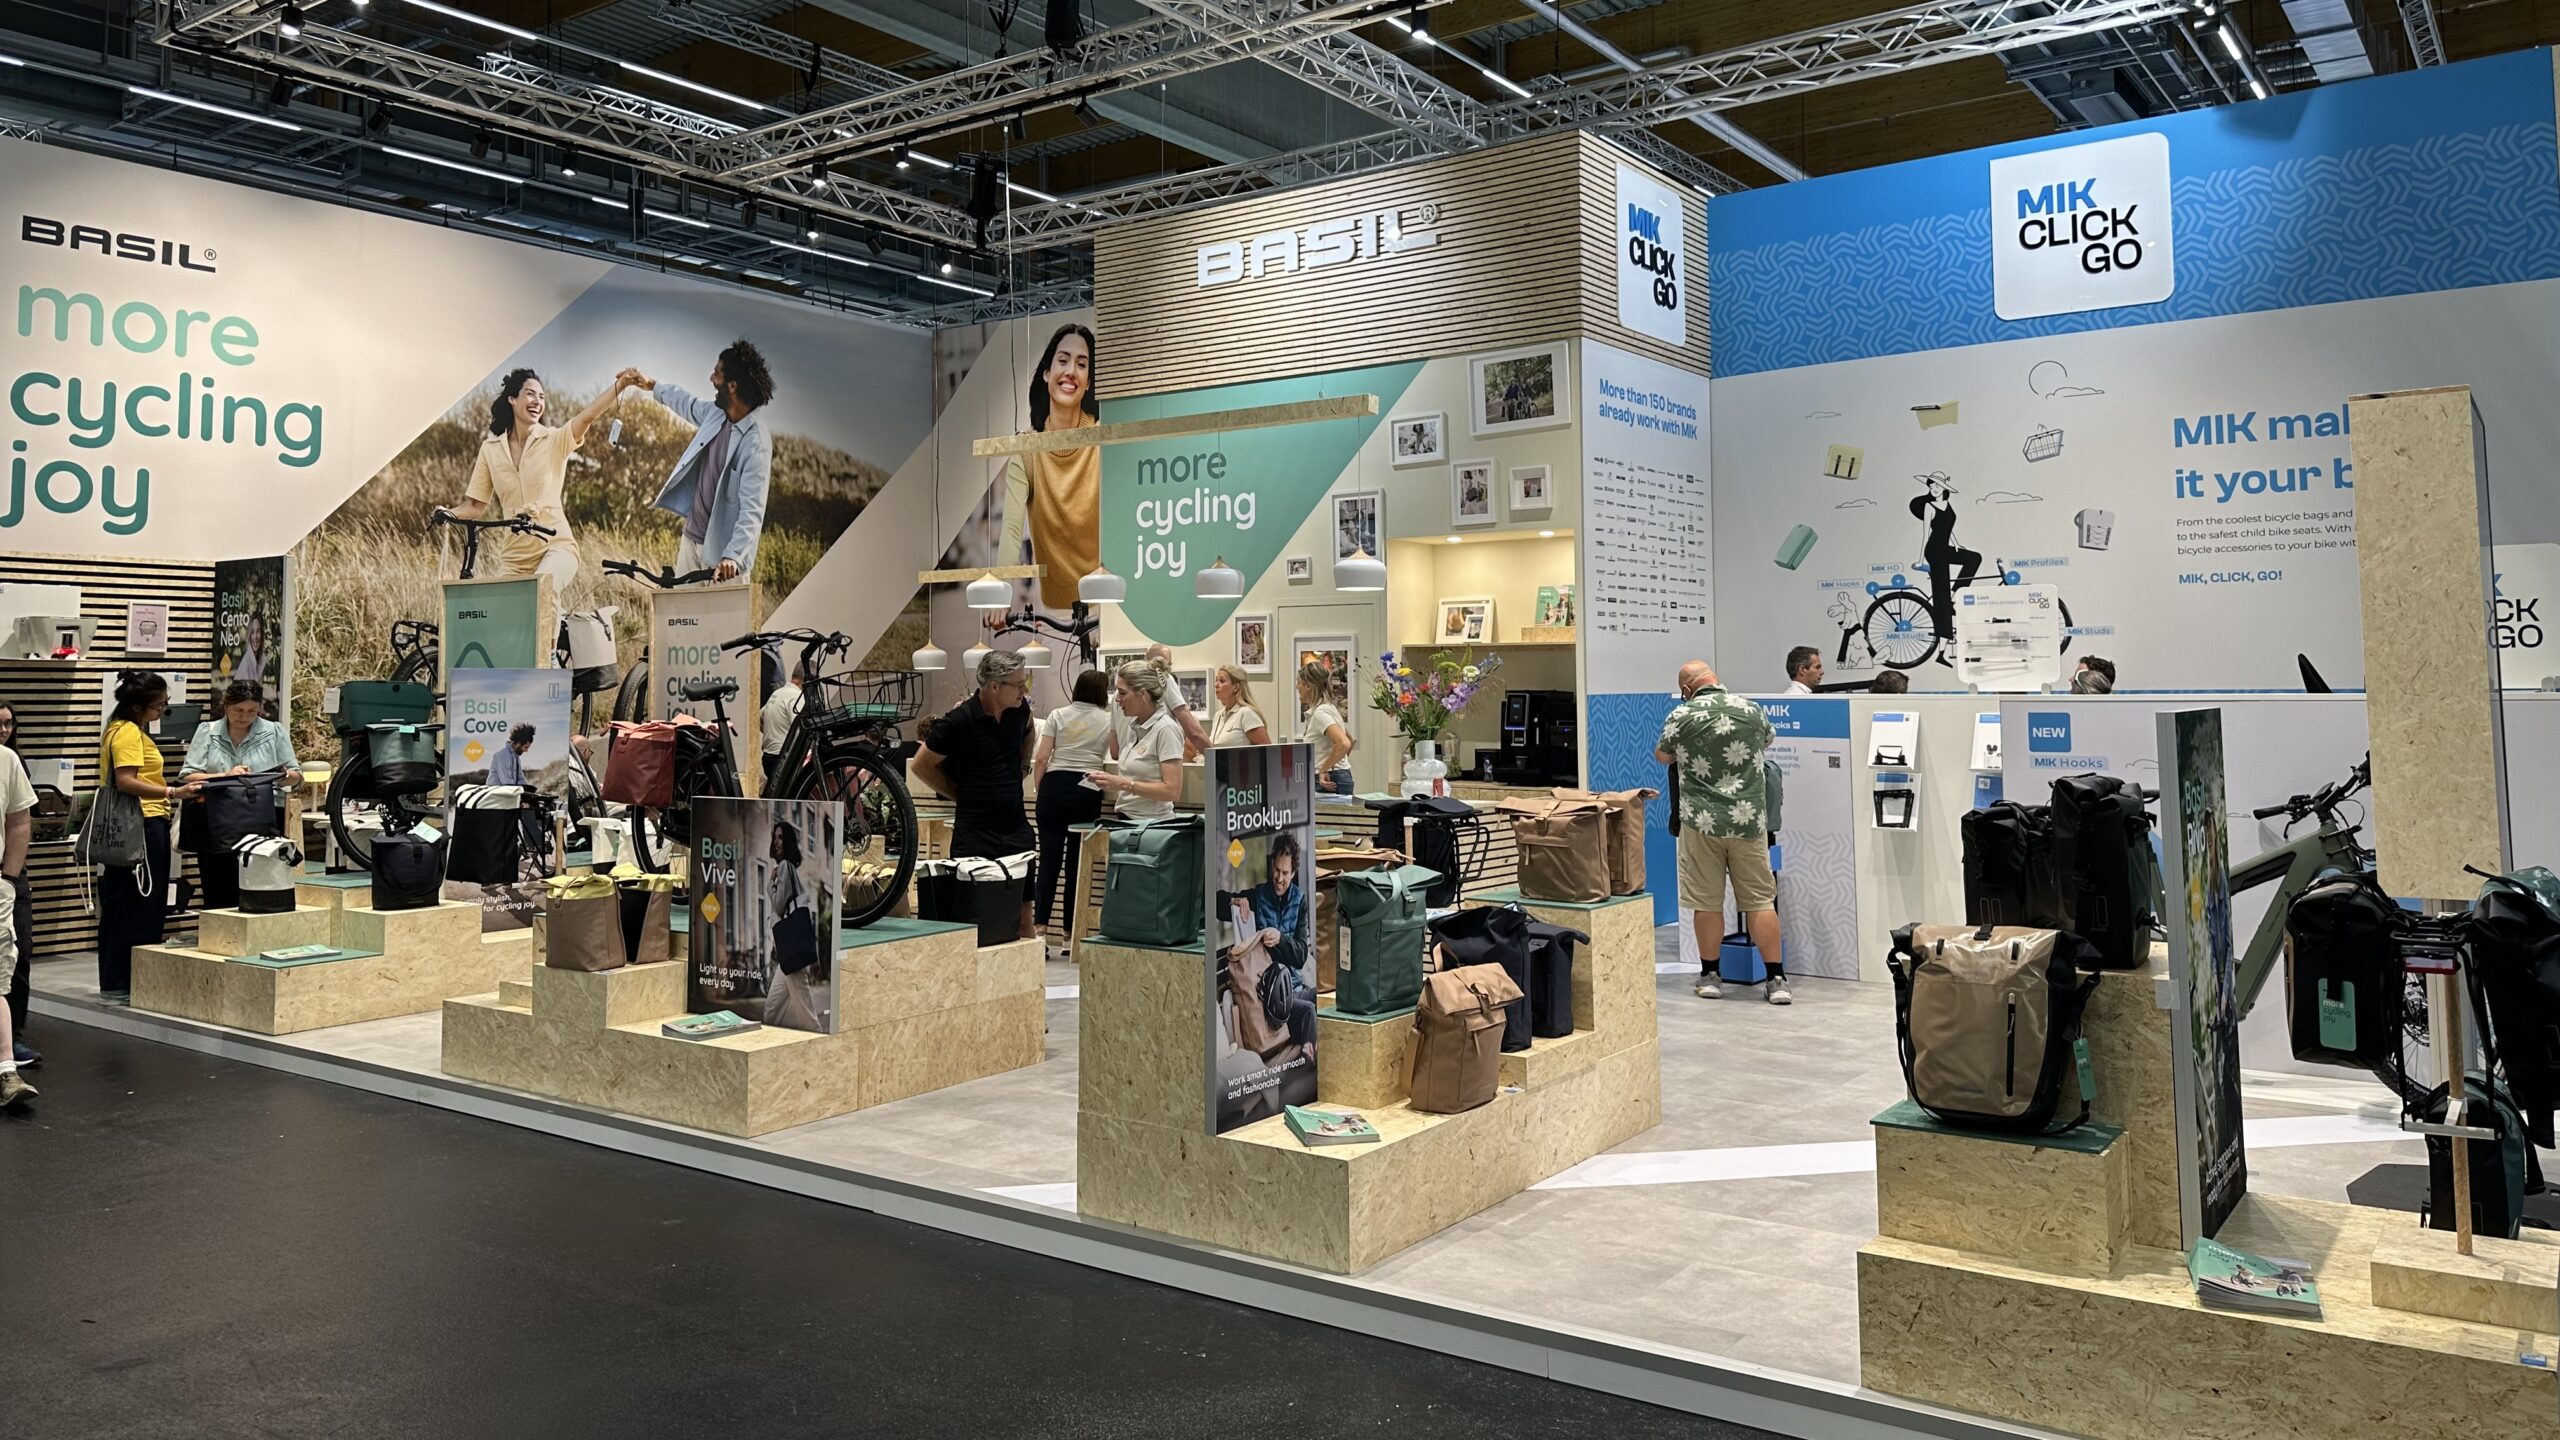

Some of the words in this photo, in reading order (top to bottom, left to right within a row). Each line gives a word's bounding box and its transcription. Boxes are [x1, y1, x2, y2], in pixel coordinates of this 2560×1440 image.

[2017, 177, 2098, 219] MIK
[1628, 203, 1661, 244] MIK
[2018, 204, 2139, 250] CLICK
[1629, 236, 1676, 281] CLICK
[2081, 238, 2143, 274] GO
[1653, 278, 1678, 310] GO
[17, 284, 260, 366] more
[1599, 378, 1626, 400] More
[1627, 387, 1648, 406] than
[1649, 392, 1666, 411] 150
[1667, 397, 1697, 420] brands
[9, 371, 323, 468] cycling
[1599, 401, 1636, 427] already
[1636, 413, 1661, 431] work
[1661, 418, 1681, 436] with
[1681, 421, 1698, 440] MIK
[2173, 411, 2258, 448] MIK
[1138, 451, 1227, 485] more
[0, 439, 150, 536] joy
[2175, 468, 2205, 499] it
[2214, 465, 2322, 504] your
[1136, 488, 1256, 535] cycling
[2176, 518, 2204, 527] From
[2206, 516, 2223, 526] the
[2225, 513, 2262, 524] coolest
[2264, 510, 2301, 523] bicycle
[2303, 508, 2330, 521] bags
[2331, 509, 2353, 518] and
[2177, 533, 2187, 541] to
[2189, 530, 2207, 539] the
[2208, 529, 2238, 539] safest
[2240, 526, 2266, 537] child
[2268, 526, 2291, 536] bike
[2293, 525, 2322, 535] seats.
[2325, 523, 2352, 533] With
[1134, 535, 1186, 579] joy
[2177, 544, 2212, 556] bicycle
[2214, 542, 2273, 553] accessories
[2274, 542, 2286, 551] to
[2287, 541, 2311, 553] your
[2314, 538, 2337, 548] bike
[2179, 574, 2208, 585] MIK,
[2210, 571, 2255, 583] CLICK,
[2257, 570, 2283, 580] GO!
[221, 591, 246, 608] Basil
[220, 610, 250, 628] Cento
[220, 630, 240, 647] Neo
[668, 645, 720, 665] more
[464, 699, 506, 715] Basil
[1763, 705, 1790, 716] MIK
[464, 717, 508, 734] Cove
[2032, 727, 2066, 738] NEW
[2034, 758, 2056, 767] MIK
[2060, 757, 2103, 768] Hooks
[1226, 783, 1262, 807] Basil
[2185, 780, 2206, 815] Basil
[1226, 805, 1292, 832] Brooklyn
[702, 837, 742, 860] Basil
[700, 862, 736, 886] Vive
[496, 902, 522, 912] cycling
[699, 963, 717, 975] Light
[718, 967, 728, 977] up
[729, 969, 746, 979] your
[747, 969, 763, 980] ride,
[699, 977, 719, 989] every
[2323, 1000, 2344, 1008] more
[2323, 1007, 2351, 1019] cycling
[2323, 1015, 2336, 1024] joy
[1228, 1074, 1246, 1087] Work
[1247, 1068, 1268, 1082] smart,
[1269, 1064, 1281, 1074] ride
[1282, 1056, 1306, 1071] smooth
[1228, 1088, 1242, 1100] and
